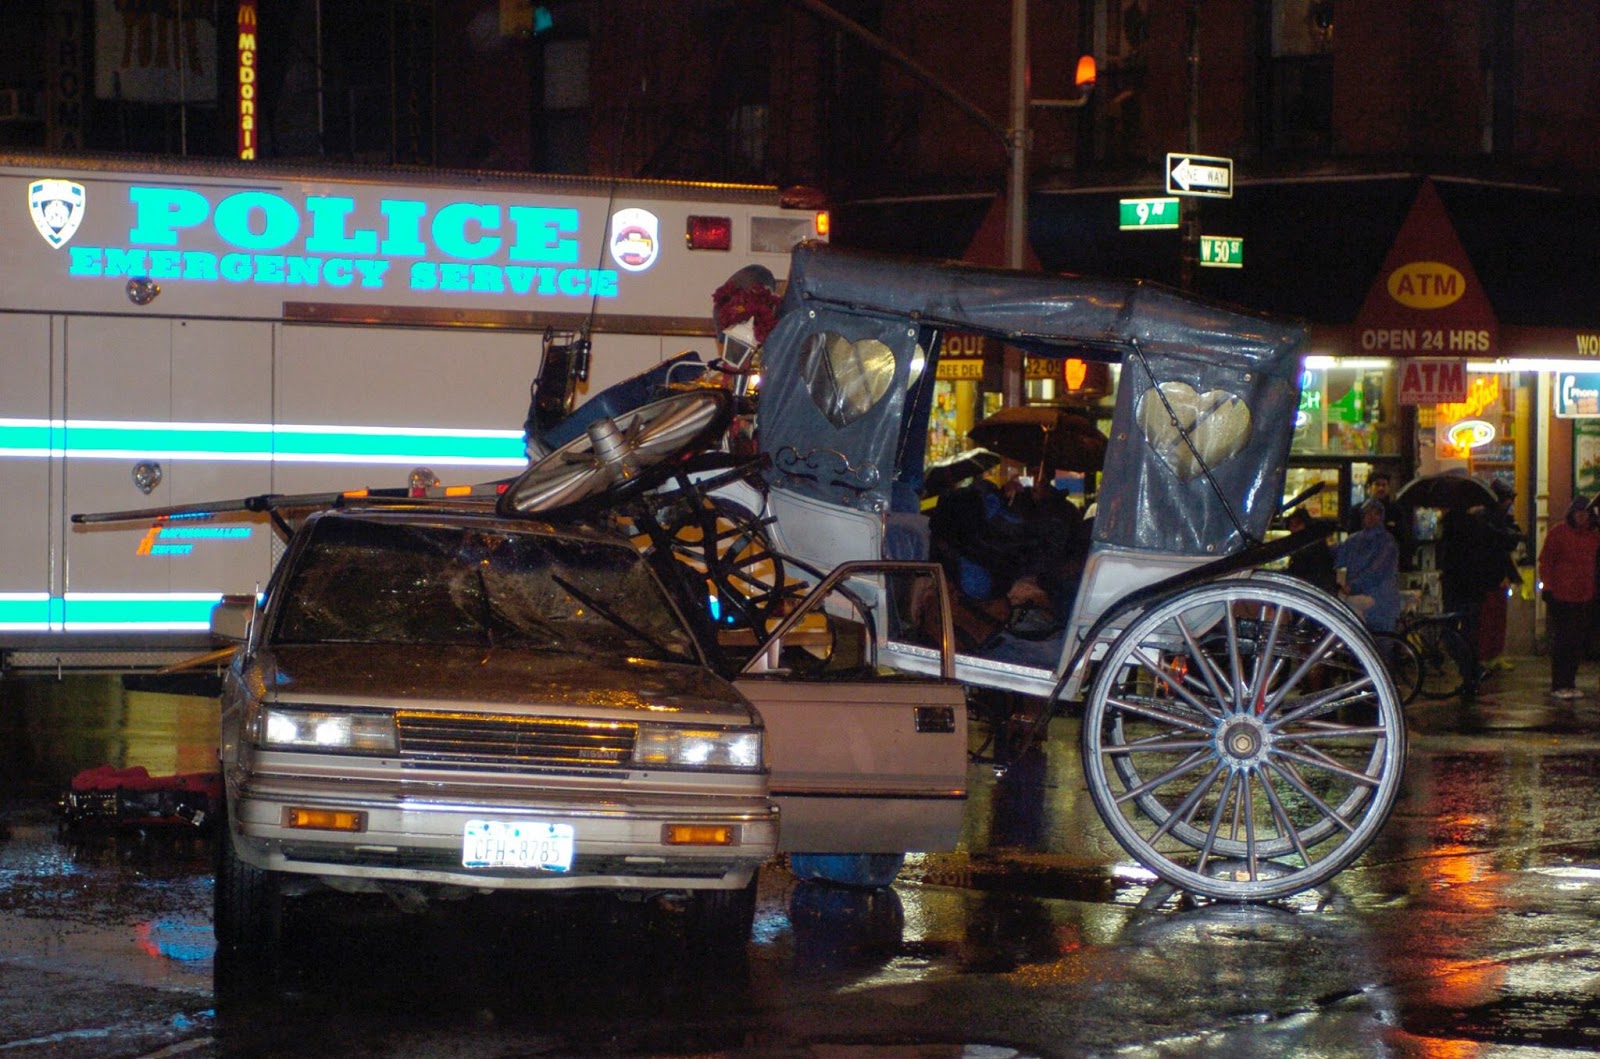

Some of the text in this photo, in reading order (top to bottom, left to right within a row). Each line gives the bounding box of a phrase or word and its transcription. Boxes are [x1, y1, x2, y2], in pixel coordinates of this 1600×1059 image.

[1179, 167, 1225, 184] ONE WAY
[129, 186, 579, 263] POLICE
[1136, 203, 1149, 225] 9
[1202, 240, 1212, 261] W
[1214, 241, 1230, 263] 50
[69, 247, 619, 297] EMERGENCY SERVICE
[1397, 273, 1457, 295] ATM
[1362, 330, 1490, 350] OPEN 24 HRS
[1577, 335, 1600, 355] WO
[1402, 363, 1463, 392] ATM
[1571, 387, 1598, 398] Phone
[578, 749, 618, 760] NISSAN
